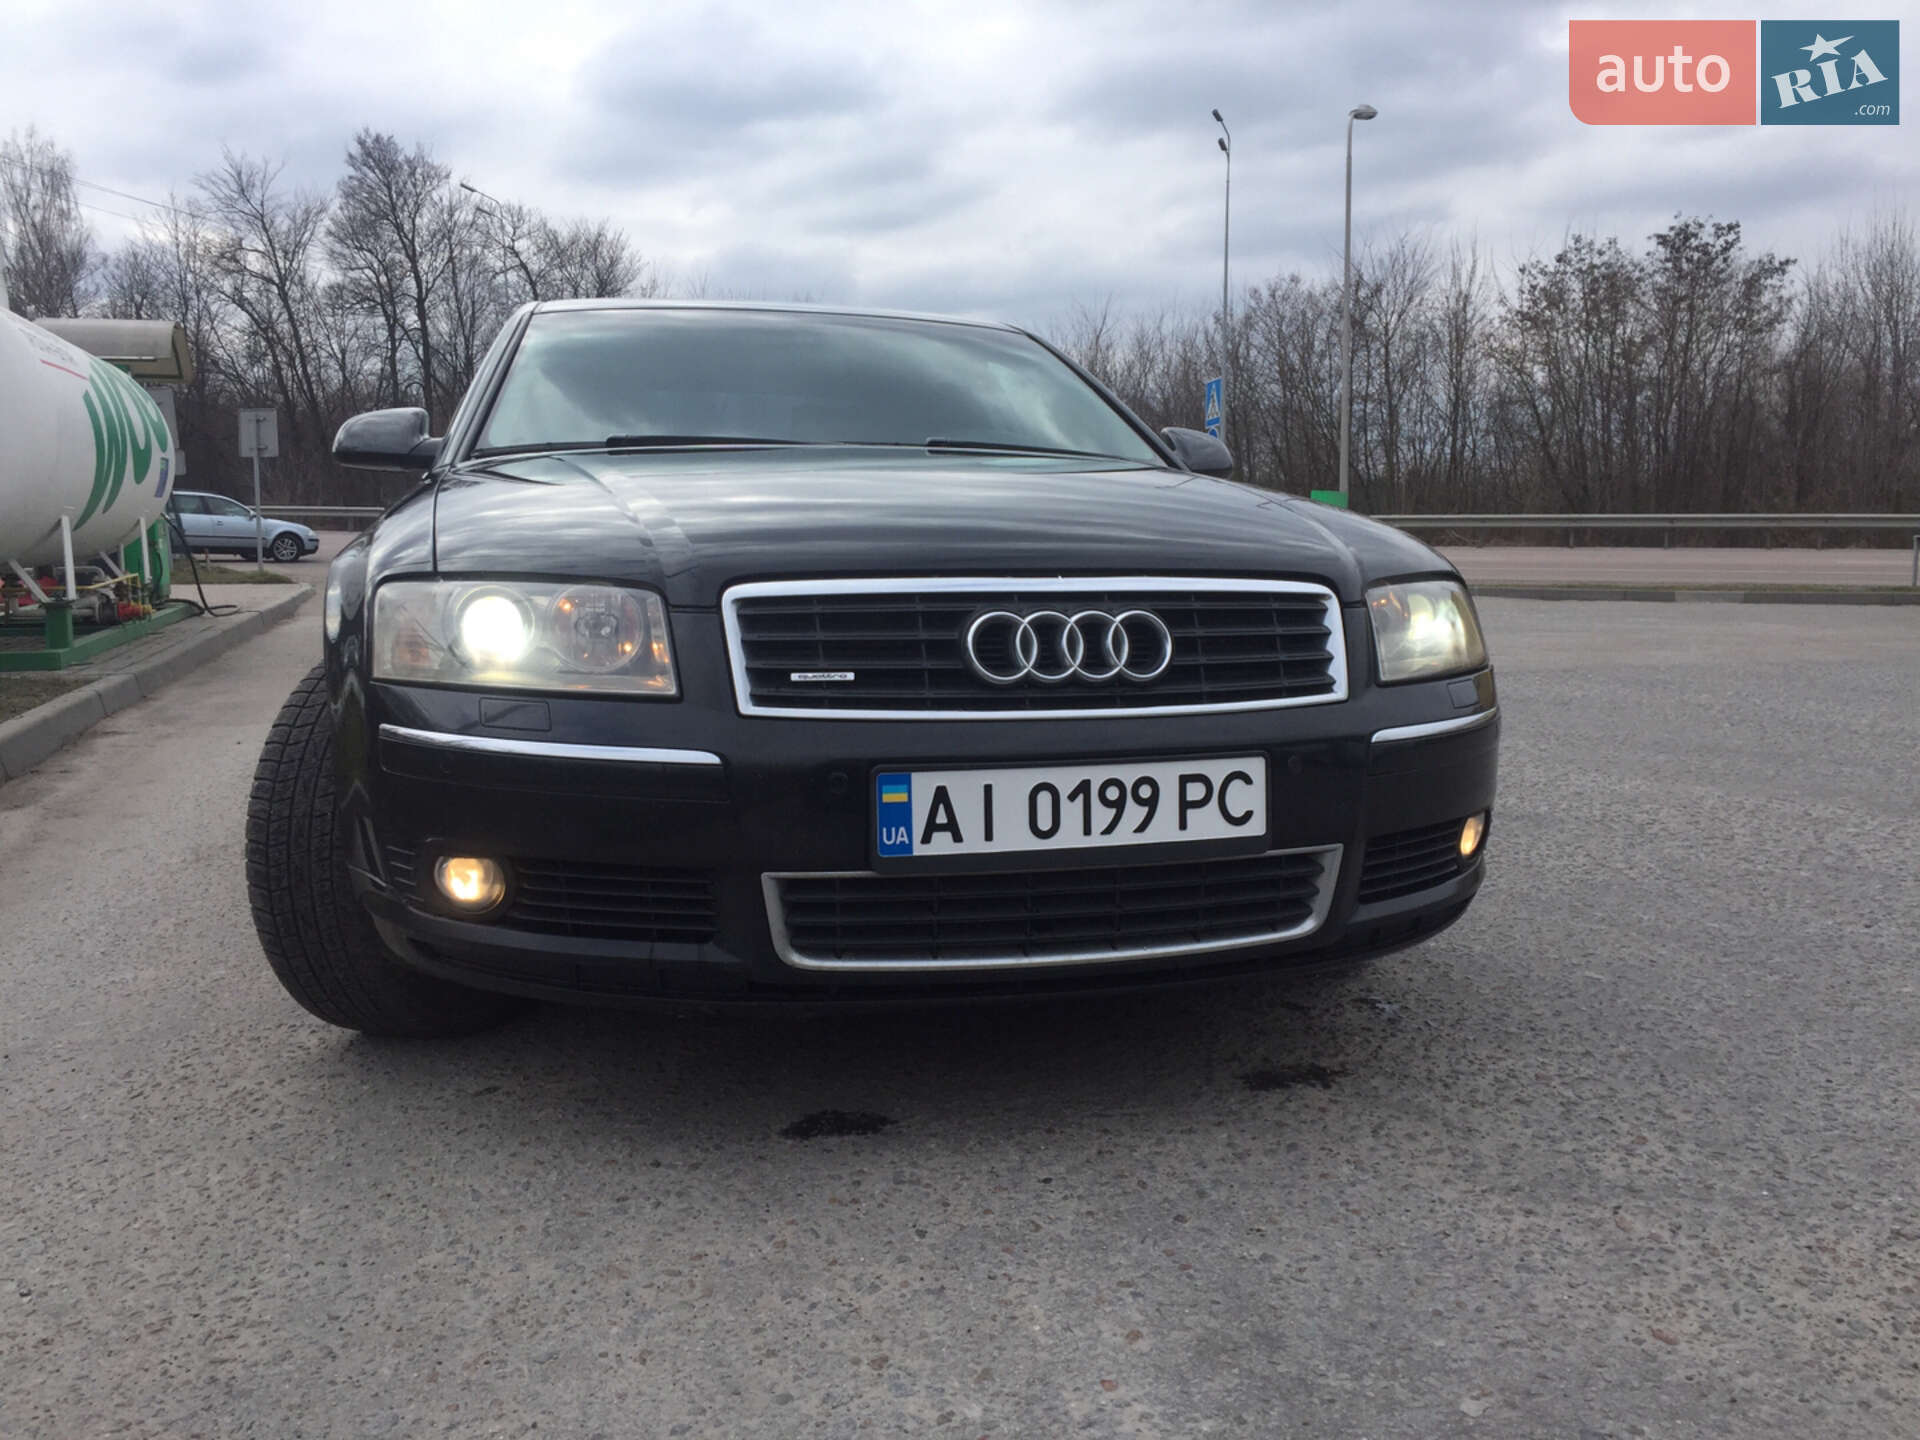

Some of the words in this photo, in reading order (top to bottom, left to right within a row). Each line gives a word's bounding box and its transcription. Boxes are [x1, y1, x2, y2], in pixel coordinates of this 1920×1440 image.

[919, 784, 994, 845] AI
[1028, 775, 1160, 840] 0199
[1178, 770, 1254, 831] PC
[882, 827, 910, 845] UA
